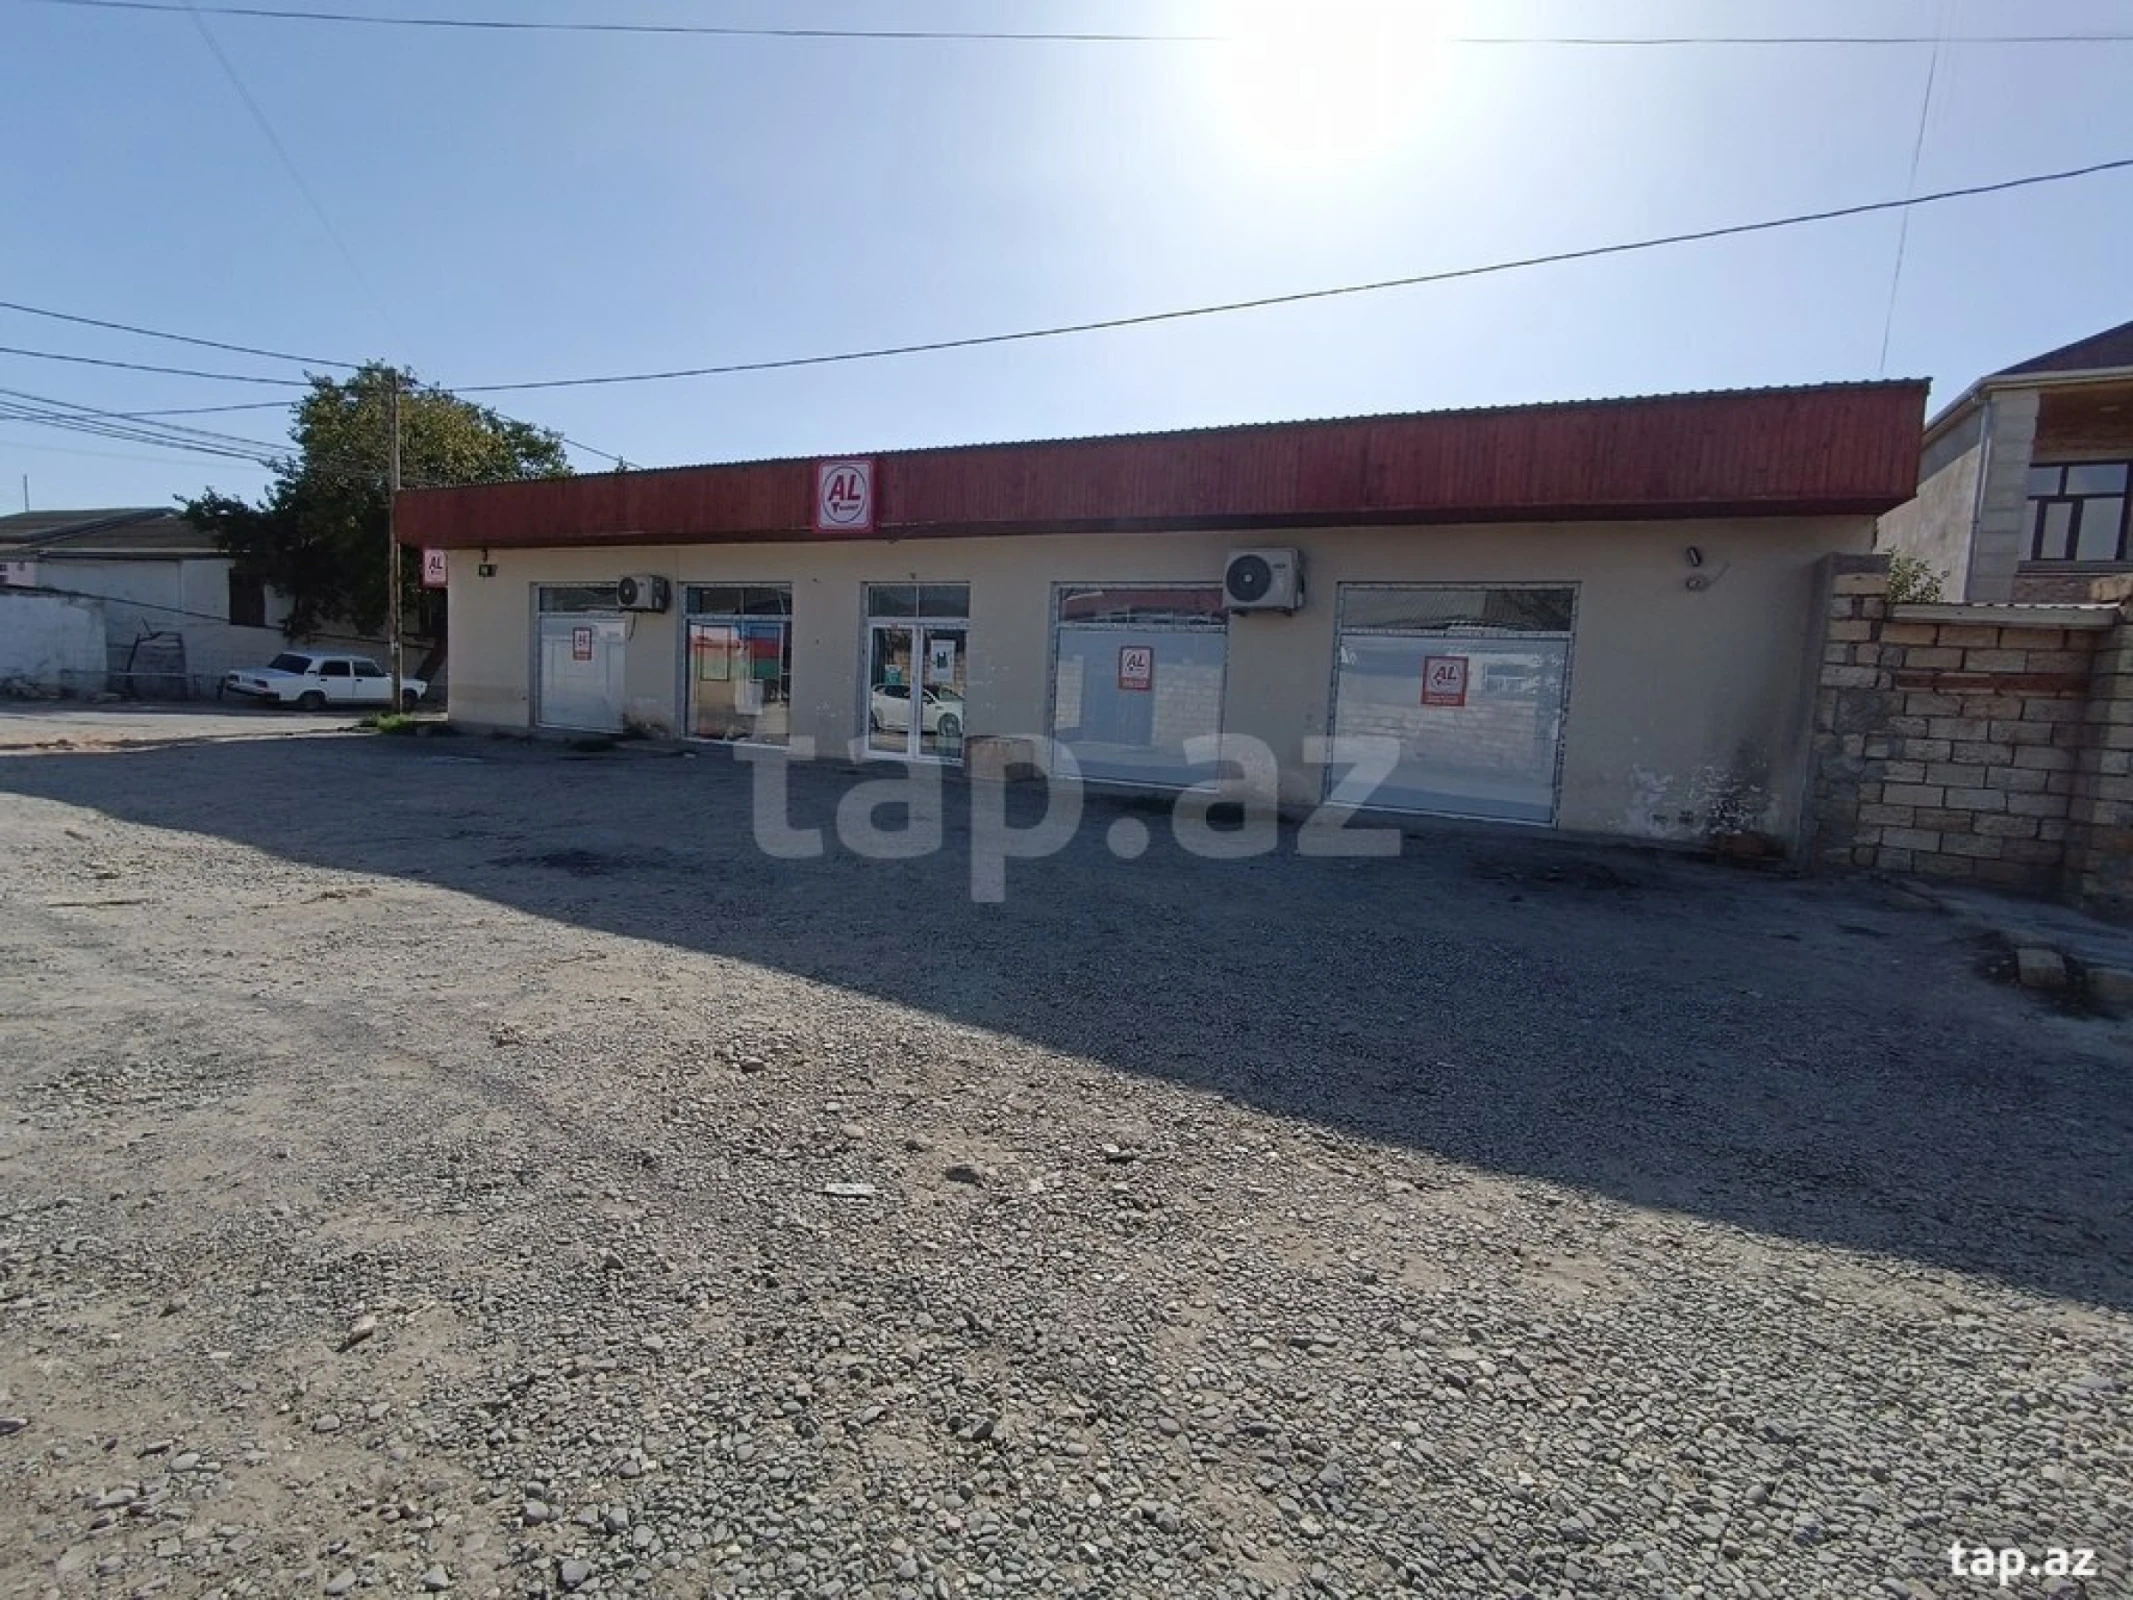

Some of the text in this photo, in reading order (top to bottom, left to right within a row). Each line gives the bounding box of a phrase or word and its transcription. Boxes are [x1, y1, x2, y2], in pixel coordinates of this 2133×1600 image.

[828, 474, 861, 501] AL
[429, 556, 443, 570] AL
[1127, 654, 1145, 667] AL
[1433, 666, 1457, 680] AL
